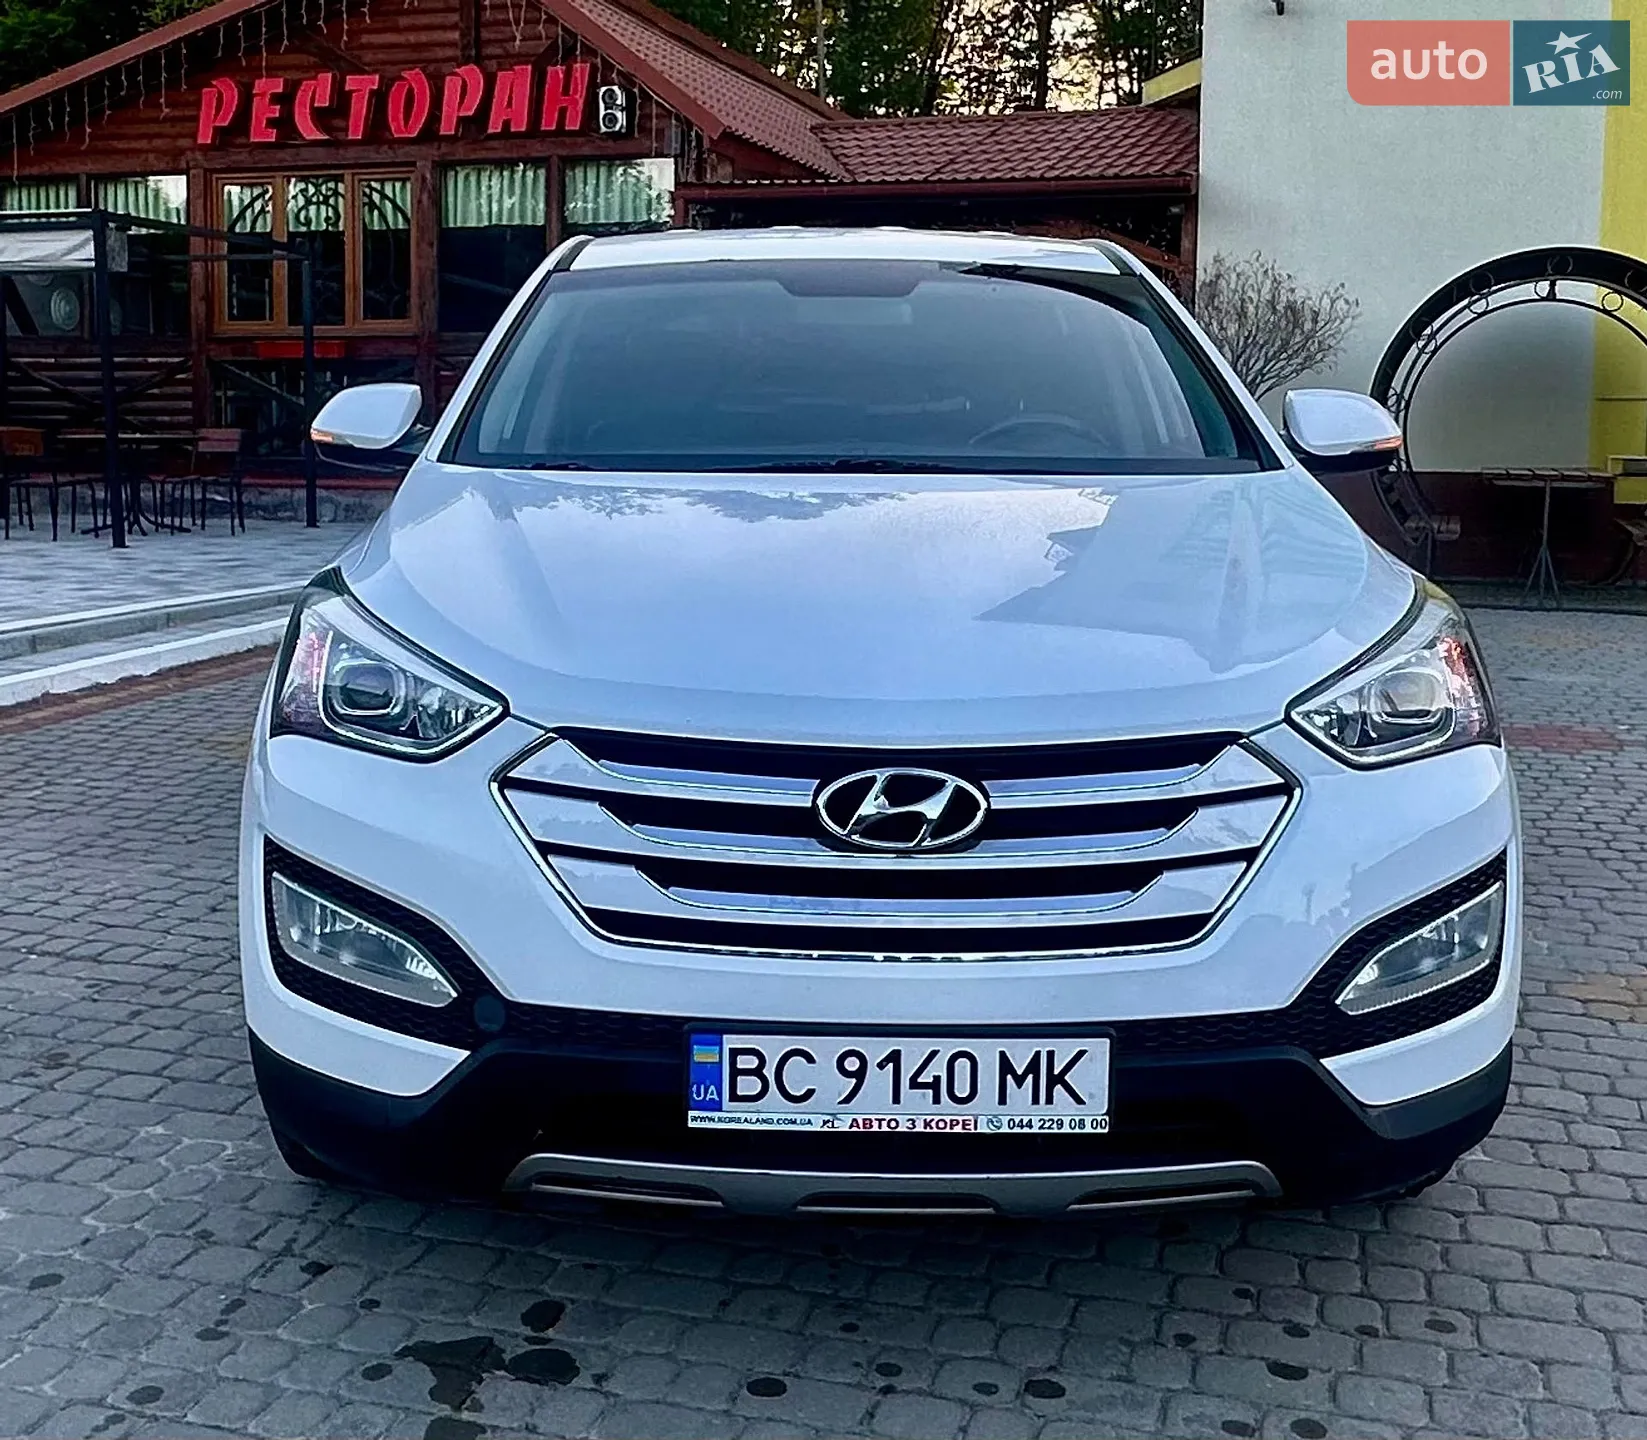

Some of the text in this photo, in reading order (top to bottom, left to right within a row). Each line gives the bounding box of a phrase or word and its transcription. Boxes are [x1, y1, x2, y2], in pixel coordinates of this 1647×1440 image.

[196, 63, 590, 144] РЕСТОРАН
[727, 1046, 1089, 1107] BC 9140 MK
[692, 1083, 719, 1102] UA
[848, 1117, 900, 1131] АВТО
[1007, 1118, 1108, 1130] 044 229 08 00
